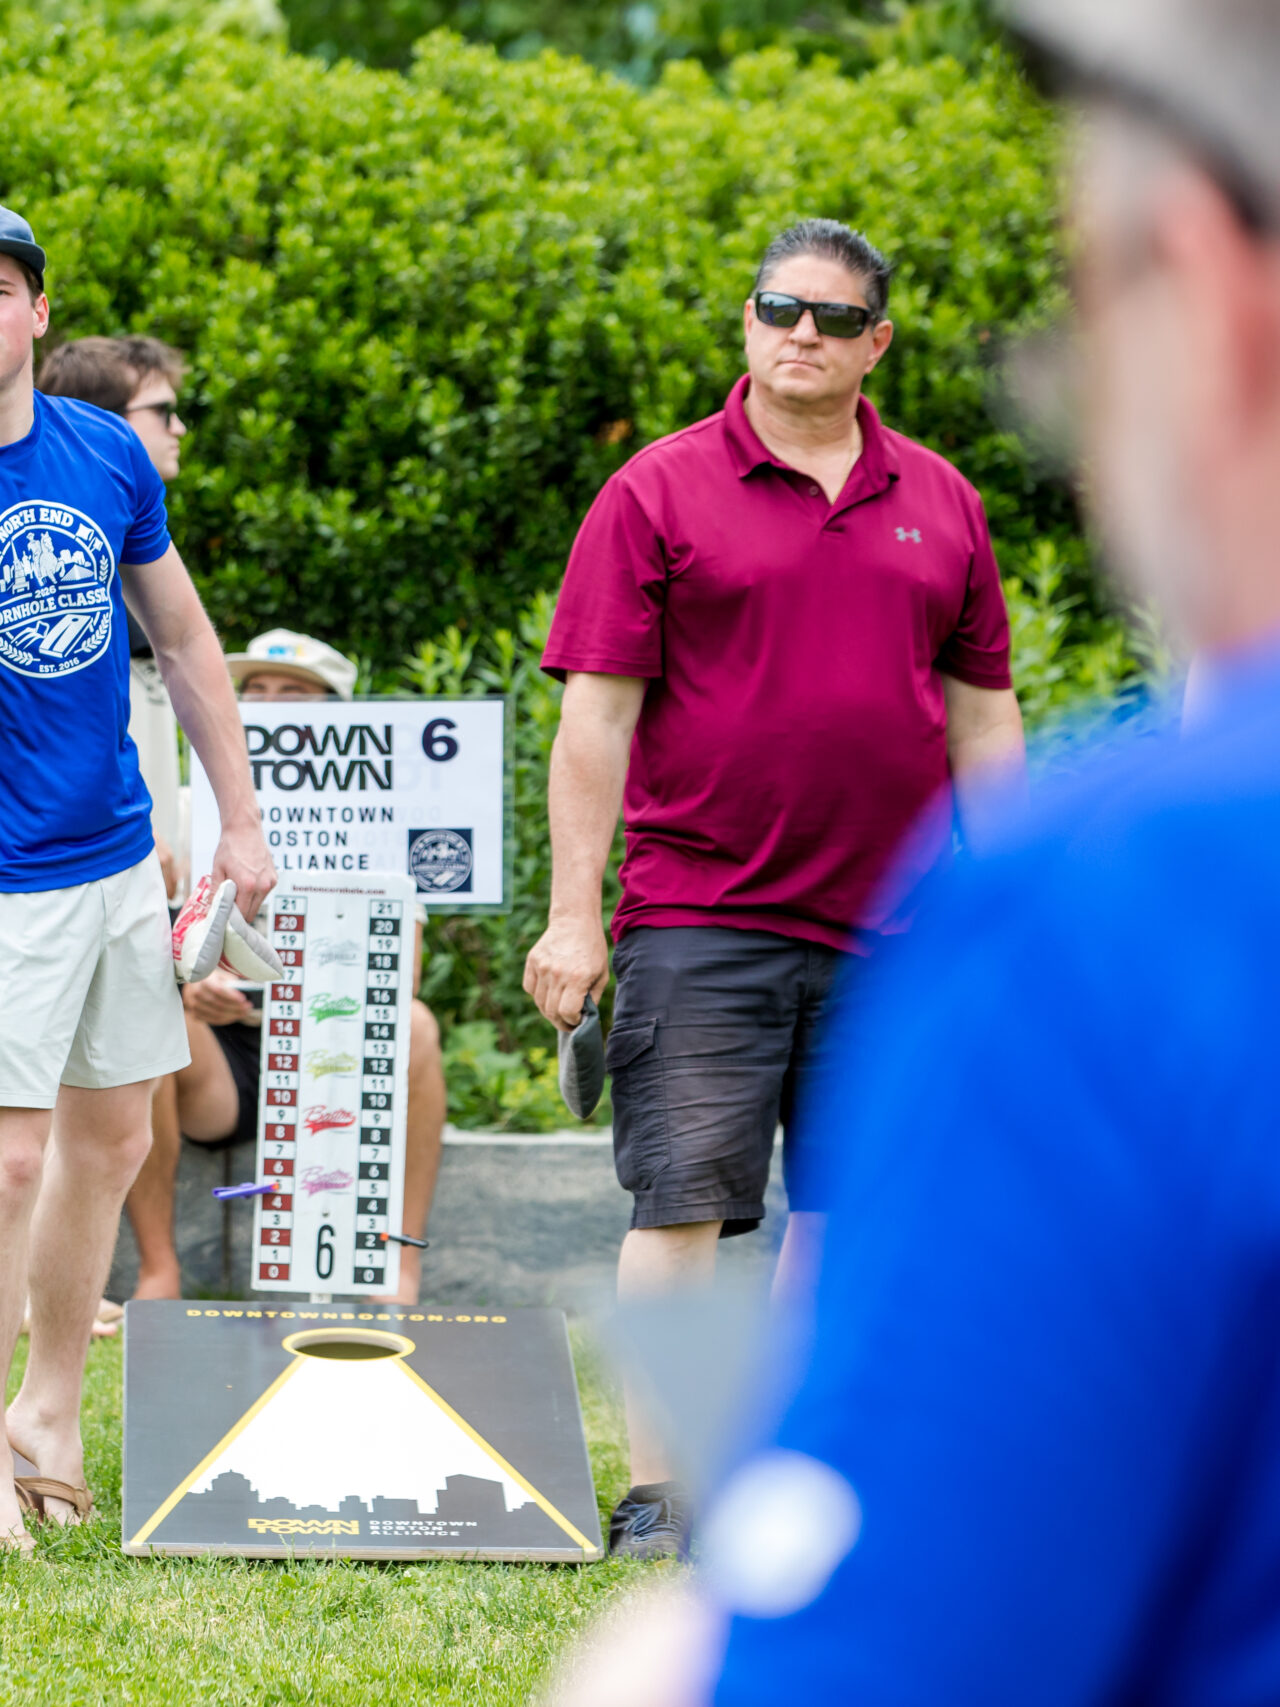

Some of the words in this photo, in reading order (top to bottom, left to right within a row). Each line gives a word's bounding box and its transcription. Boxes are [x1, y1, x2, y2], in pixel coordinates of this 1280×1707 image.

[39, 508, 74, 527] END
[39, 664, 57, 673] EST.
[59, 657, 80, 671] 2016
[244, 724, 392, 756] DOWN
[422, 718, 459, 761] 6
[250, 760, 392, 791] TOWN
[269, 830, 348, 847] OSTON
[273, 854, 369, 870] LIANCE
[282, 900, 297, 910] 21
[378, 904, 393, 914] 21
[279, 916, 298, 930] 20
[374, 920, 394, 934] 20
[282, 935, 297, 946] 19
[378, 939, 393, 950] 19
[280, 951, 296, 965] 18
[374, 955, 392, 969] 18
[376, 974, 391, 985] 17
[277, 986, 294, 999] 16
[372, 990, 390, 1004] 16
[279, 1005, 294, 1016] 15
[375, 1009, 390, 1020] 15
[276, 1021, 294, 1034] 14
[371, 1025, 389, 1038] 14
[278, 1040, 292, 1051] 13
[373, 1044, 388, 1055] 13
[275, 1056, 293, 1069] 12
[370, 1060, 388, 1073] 12
[276, 1074, 290, 1085] 11
[372, 1079, 386, 1089] 11
[274, 1090, 291, 1104] 10
[368, 1095, 387, 1108] 10
[278, 1109, 286, 1120] 9
[373, 1114, 381, 1124] 9
[275, 1125, 286, 1139] 8
[370, 1129, 381, 1143] 8
[276, 1144, 284, 1155] 7
[372, 1148, 379, 1159] 7
[273, 1161, 284, 1174] 6
[368, 1165, 379, 1178] 6
[370, 1183, 378, 1194] 5
[272, 1195, 282, 1209] 4
[367, 1200, 378, 1213] 4
[273, 1214, 280, 1226] 3
[369, 1218, 376, 1229] 3
[270, 1230, 281, 1244] 2
[365, 1234, 376, 1248] 2
[272, 1249, 278, 1260] 1
[316, 1224, 335, 1280] 6
[368, 1253, 373, 1264] 1
[268, 1265, 279, 1278] 0
[363, 1269, 374, 1282] 0
[187, 1309, 507, 1324] DOWNTOWNBOSTON.ORG
[248, 1518, 359, 1528] DOWN
[257, 1527, 359, 1535] TOWN
